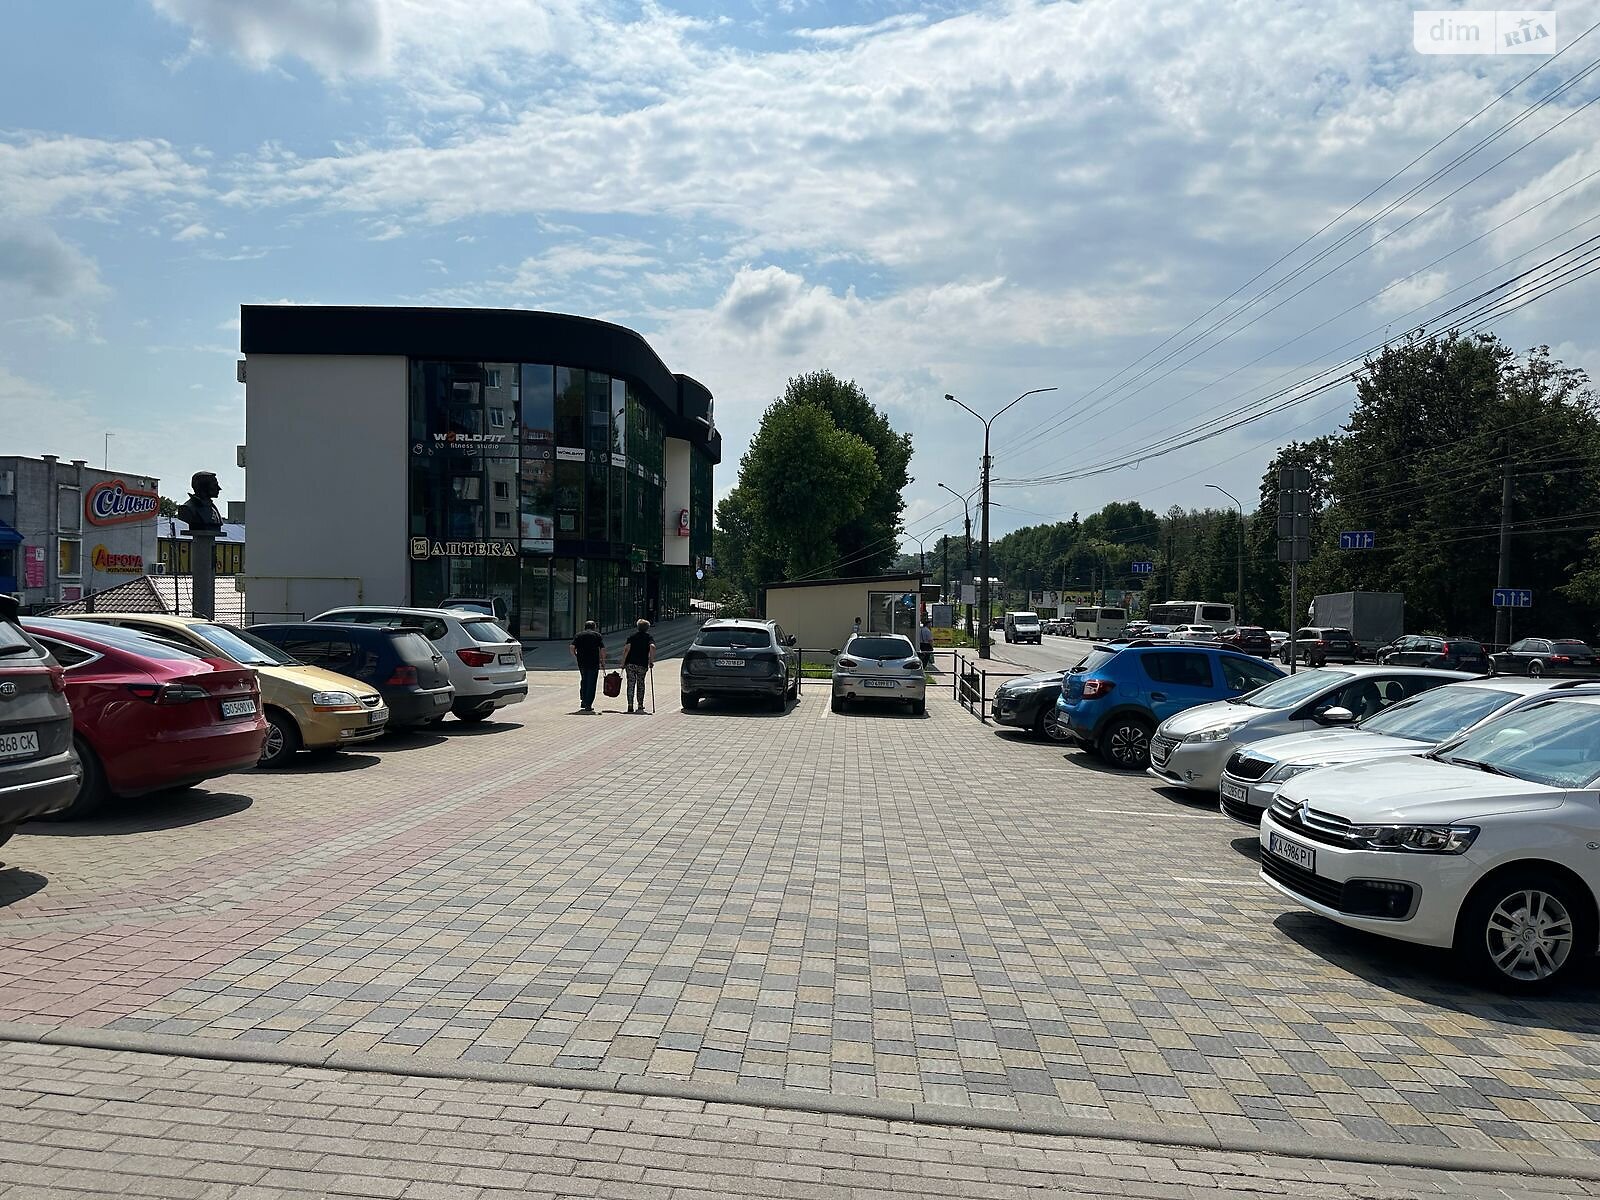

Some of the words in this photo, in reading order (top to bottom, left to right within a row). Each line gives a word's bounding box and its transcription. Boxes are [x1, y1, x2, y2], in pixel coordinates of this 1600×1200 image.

[95, 488, 157, 516] Сільпо
[431, 542, 516, 556] АПТЕКА
[20, 734, 35, 749] CK
[1274, 838, 1283, 853] KA
